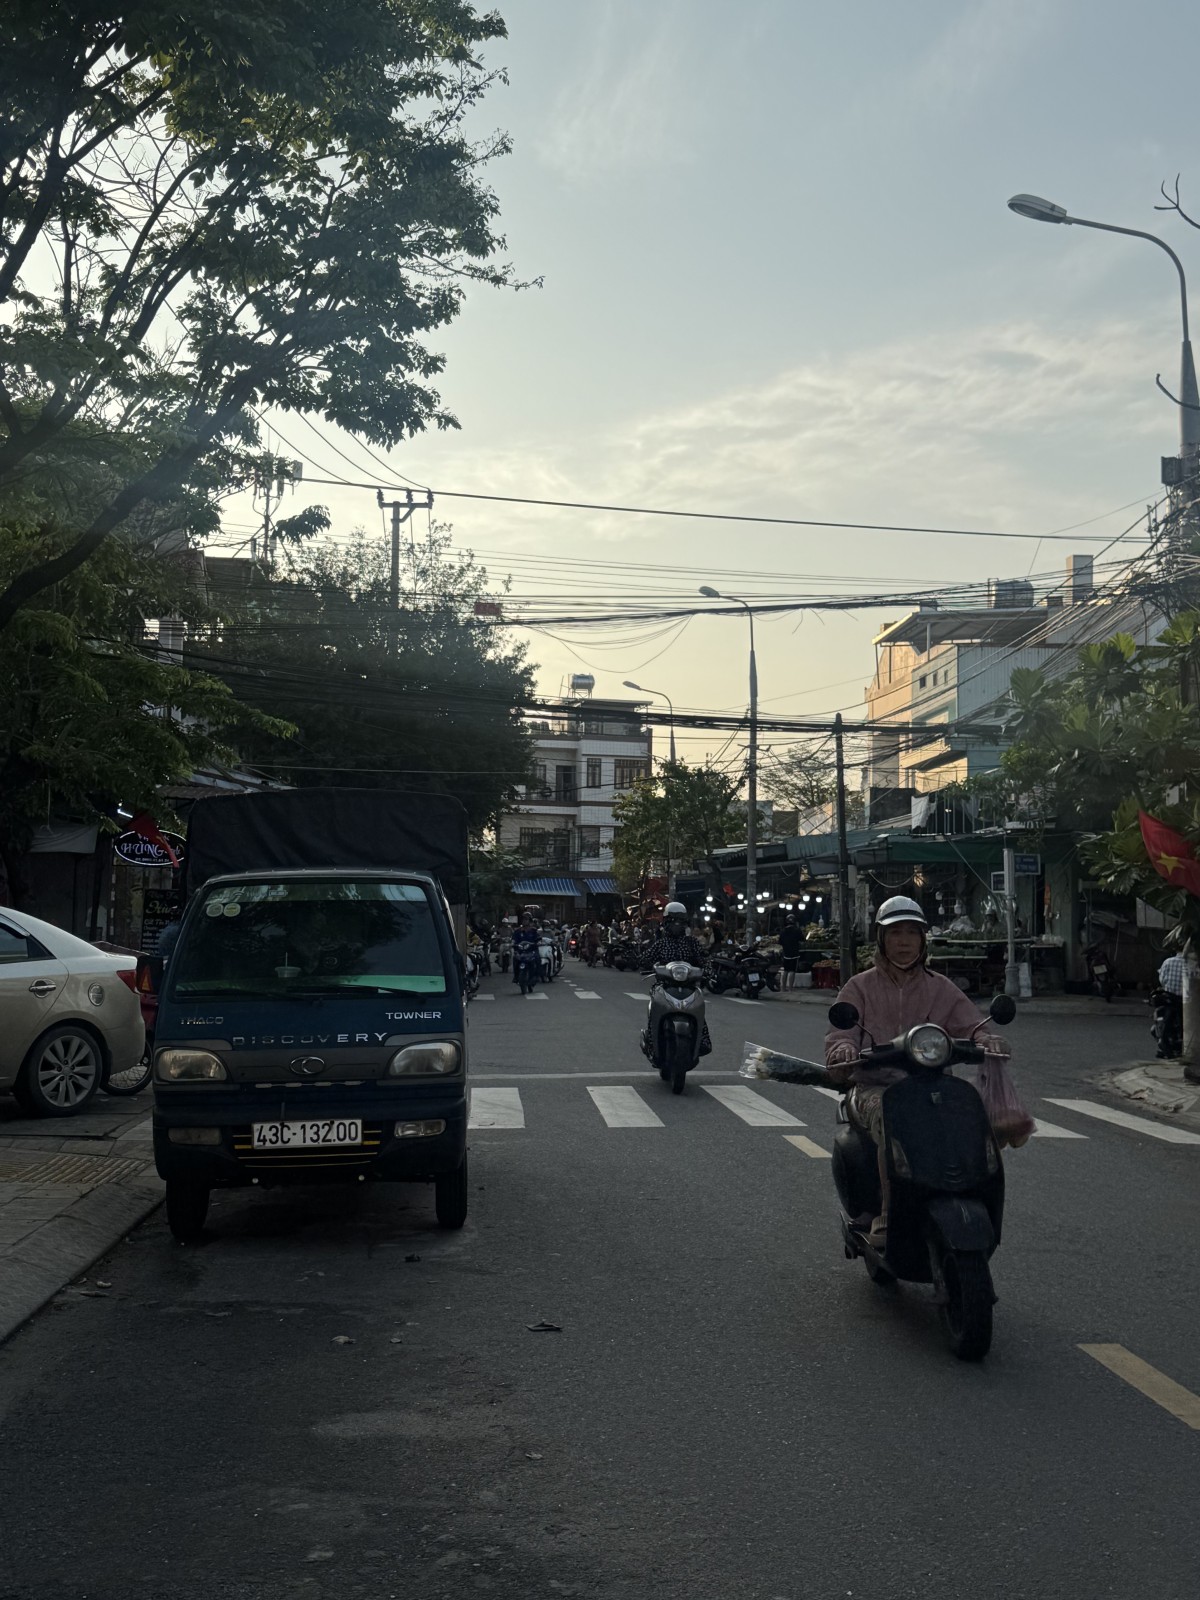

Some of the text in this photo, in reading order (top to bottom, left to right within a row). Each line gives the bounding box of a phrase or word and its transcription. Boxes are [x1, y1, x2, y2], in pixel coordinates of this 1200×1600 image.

[120, 841, 164, 858] HÙNG
[179, 1016, 224, 1026] THACO
[385, 1011, 442, 1020] TOWNER
[232, 1032, 388, 1046] DISCOVERY
[257, 1121, 359, 1146] 43C-132.00
